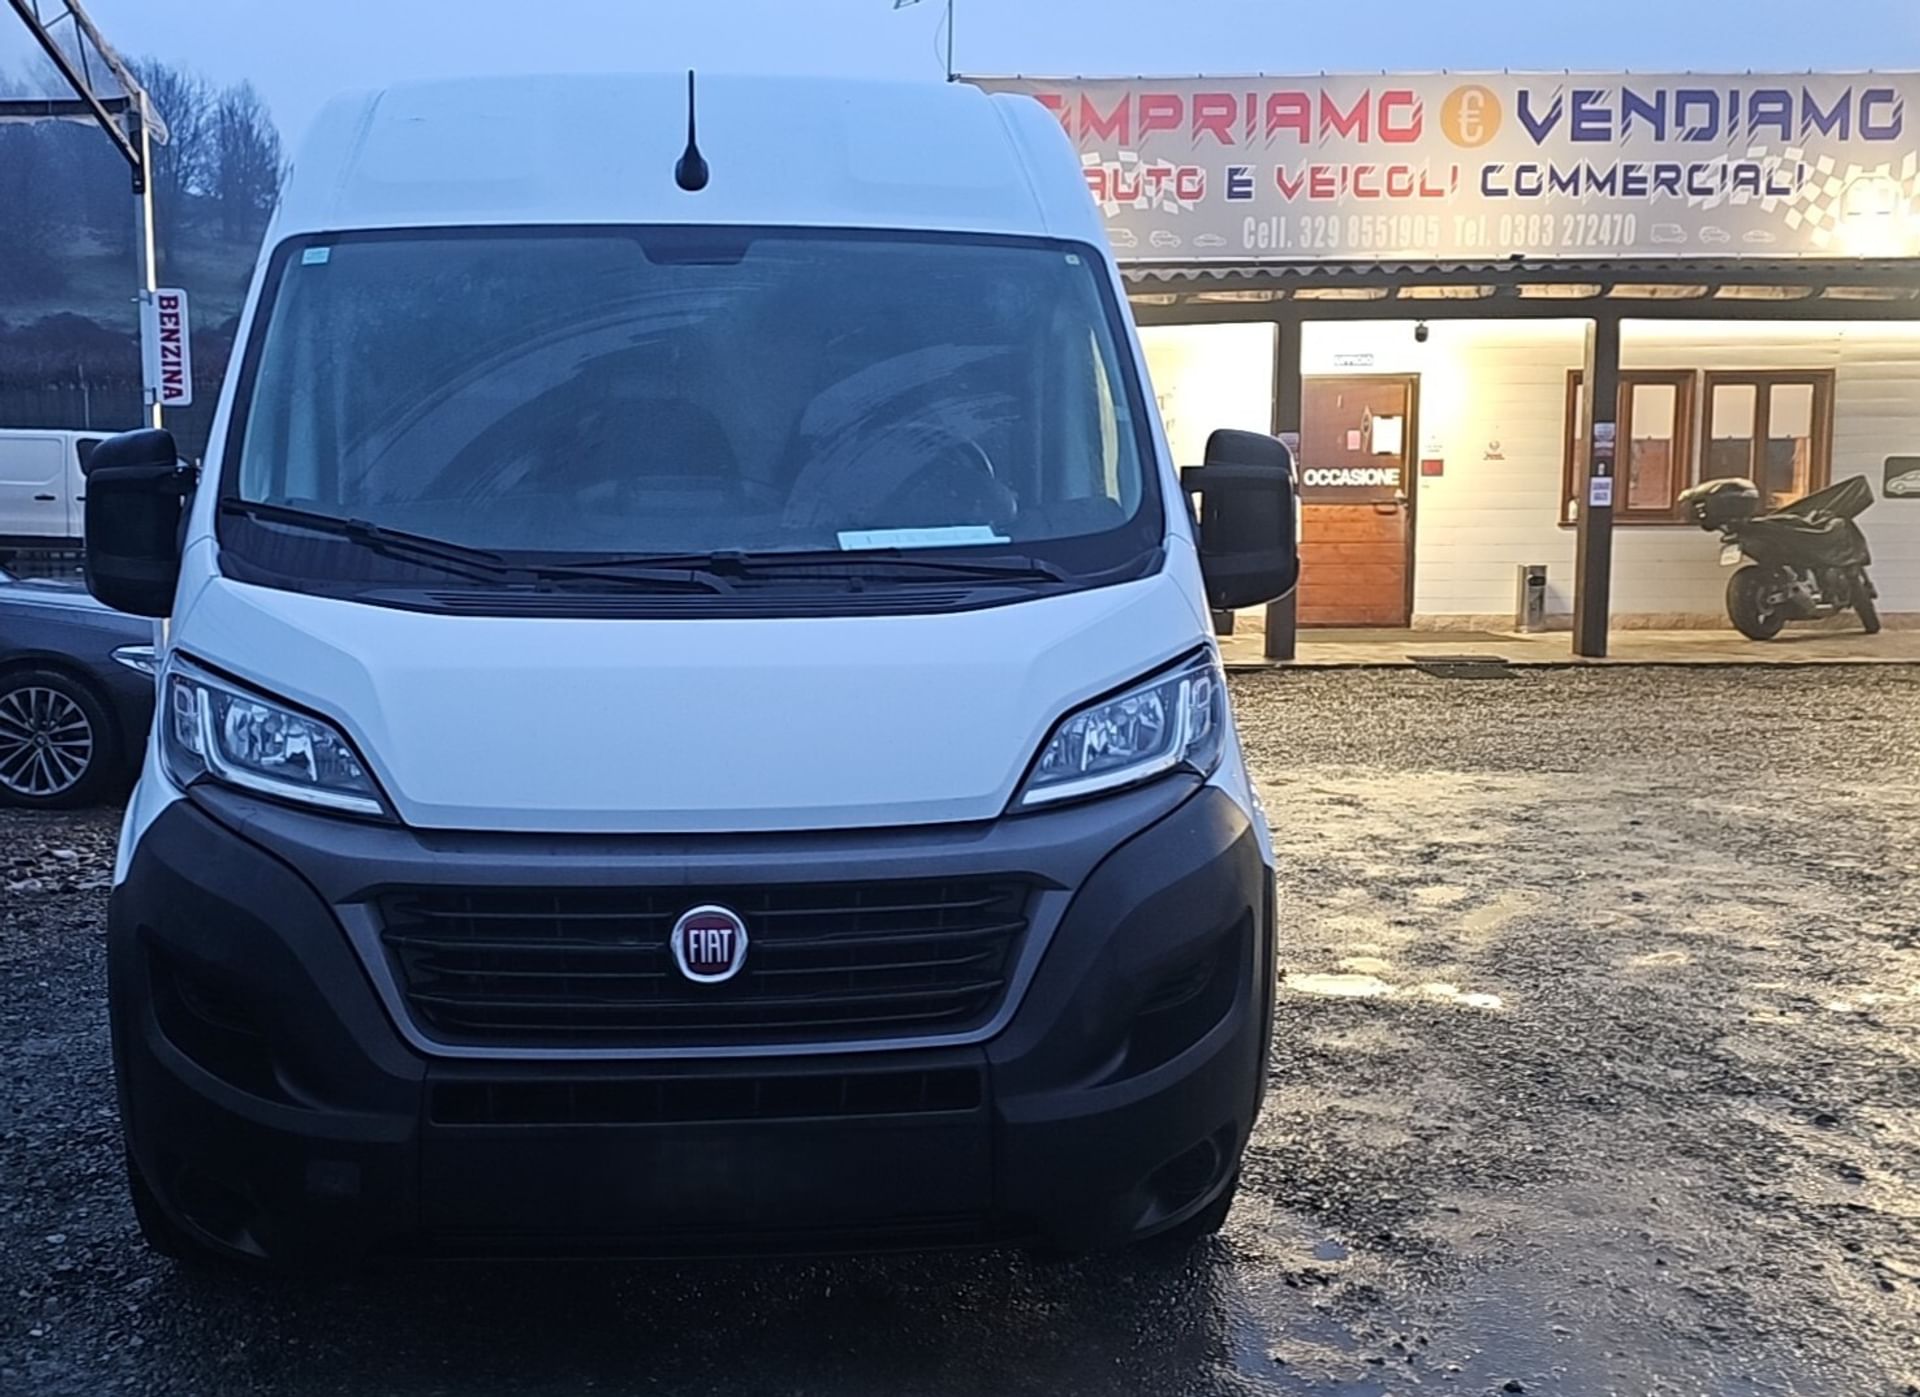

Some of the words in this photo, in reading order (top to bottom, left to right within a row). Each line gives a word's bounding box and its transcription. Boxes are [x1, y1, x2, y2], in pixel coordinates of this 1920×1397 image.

[1516, 85, 1904, 147] VENDIAMO
[1082, 168, 1204, 201] AUTO
[1228, 166, 1253, 200] E
[1276, 165, 1459, 200] VEICOLI
[1481, 163, 1806, 198] COMMERCIALI
[1243, 216, 1292, 249] Cell.
[1300, 215, 1340, 248] 329
[1349, 214, 1440, 248] 8551905
[1454, 215, 1491, 247] Tel.
[1500, 213, 1554, 247] 0383
[1562, 212, 1636, 246] 272470
[158, 295, 184, 401] BENZINA
[1303, 468, 1401, 486] OCCASIONE
[688, 929, 732, 963] FIAT
